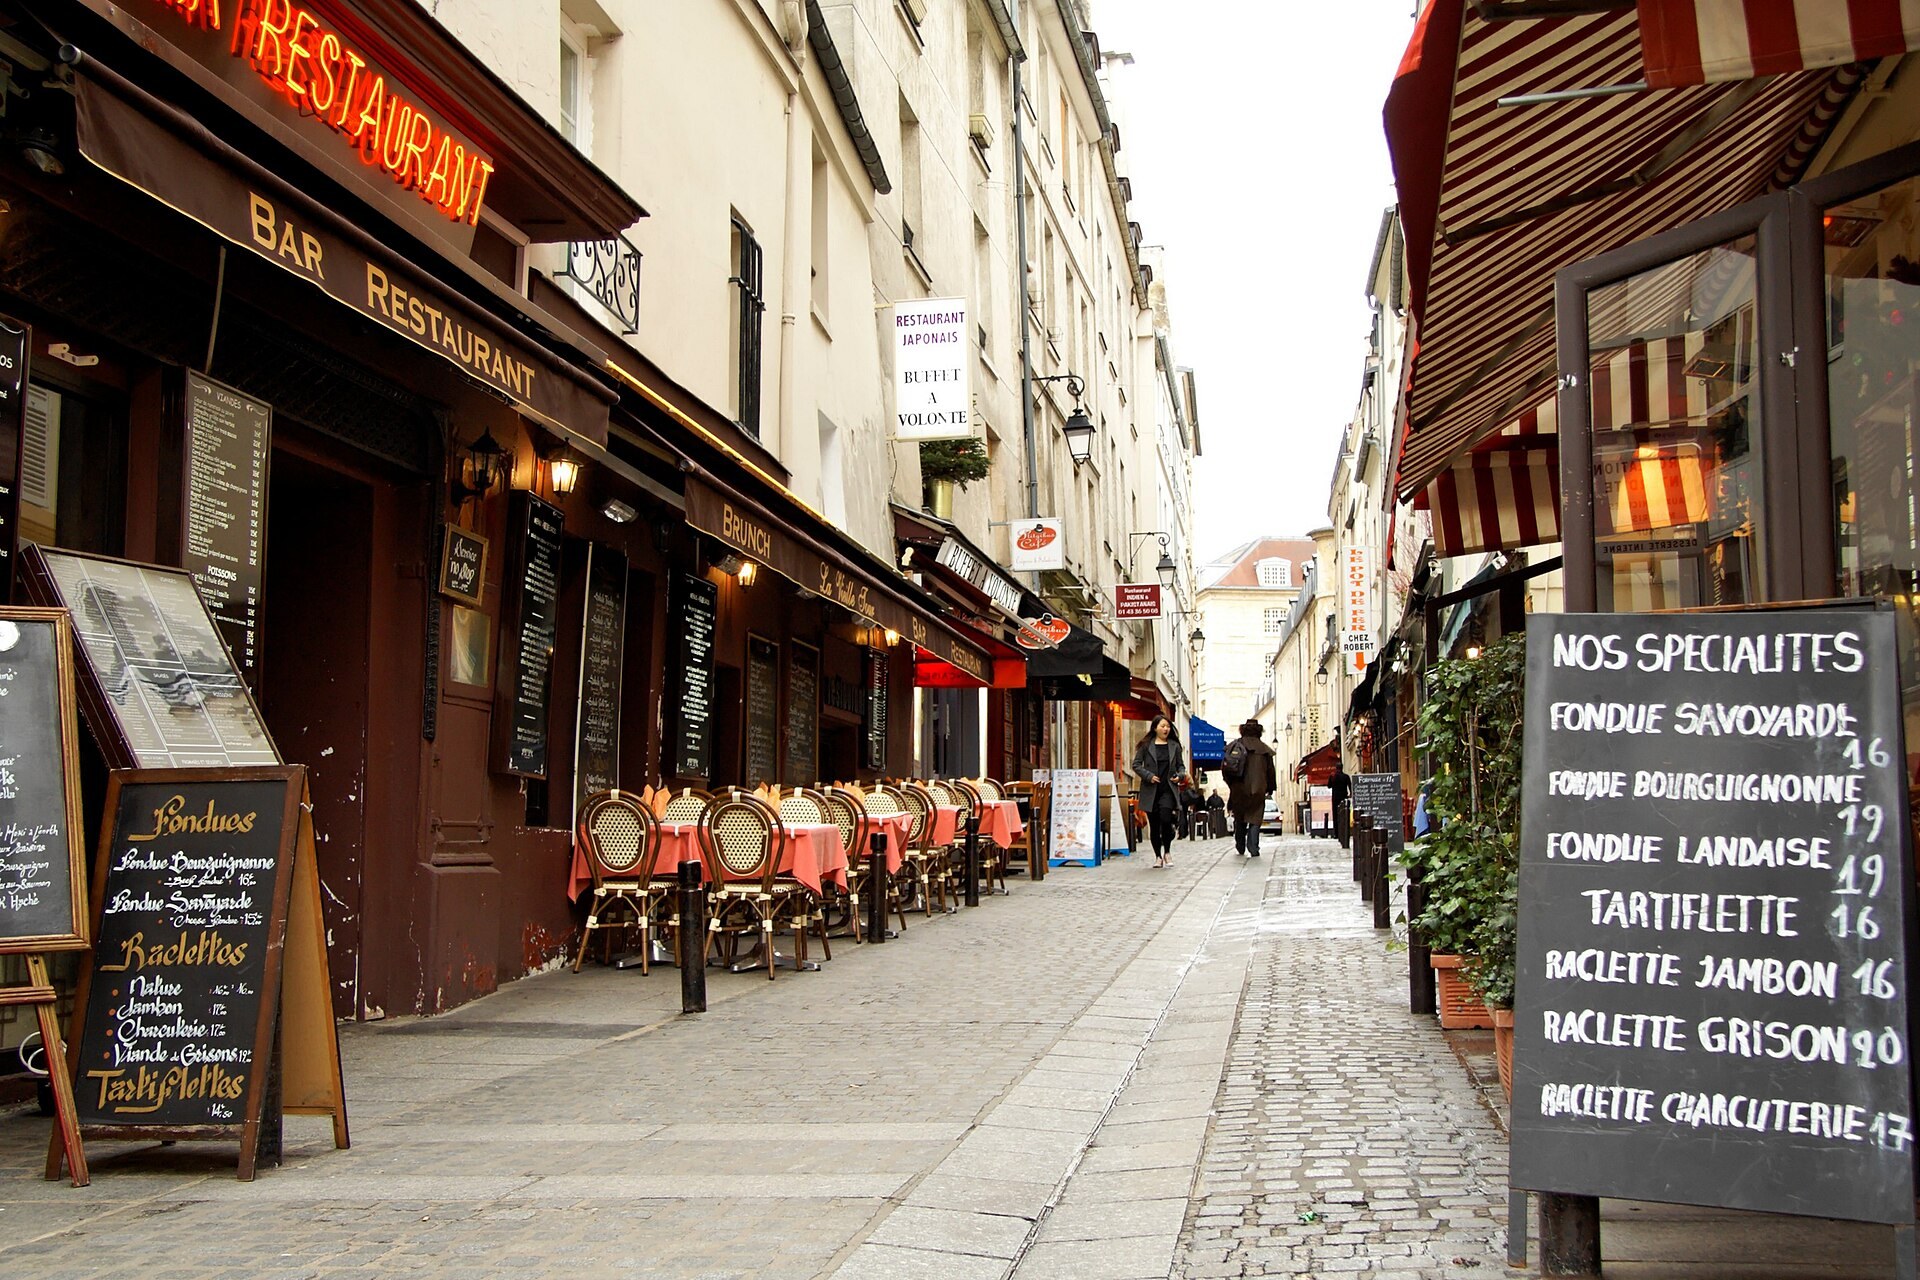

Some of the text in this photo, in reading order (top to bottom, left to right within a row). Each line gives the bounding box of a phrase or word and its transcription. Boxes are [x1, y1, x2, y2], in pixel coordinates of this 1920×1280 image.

[257, 0, 495, 226] RESTAURANT
[250, 192, 535, 400] BAR RESTAURANT
[896, 311, 965, 327] RESTAURANT
[903, 331, 958, 346] JAPONAIS
[904, 368, 962, 384] BUFFET
[216, 392, 241, 408] VIANDES
[927, 391, 938, 405] A
[898, 411, 967, 427] VOLONTE
[723, 503, 771, 559] BRUNCH
[207, 564, 236, 581] POISSONS
[948, 545, 1019, 612] BUFFET A VOLONTE
[1350, 566, 1364, 586] POT
[1351, 591, 1365, 604] DE
[912, 616, 927, 646] BAR
[1343, 642, 1374, 651] ROBERT
[1348, 634, 1369, 642] CHEZ
[1553, 632, 1865, 674] NOS SPECIALITES
[1550, 702, 1858, 737] FONDUE SAVOYARDE
[1842, 738, 1891, 769] 16
[1549, 770, 1866, 804] FONDUE BOURGUIGNONNE
[128, 794, 257, 842] Fondues
[1837, 804, 1885, 843] 19
[113, 847, 276, 880] Fondue Bourguignonne
[1547, 832, 1832, 870] FONDUE LANDAISE
[1831, 853, 1885, 899] 19
[105, 888, 253, 917] Fondue Savoyarde
[1580, 888, 1881, 941] TARTIFLETTE 16
[100, 931, 249, 972] Raclettes
[129, 974, 183, 997] Nature
[1545, 949, 1897, 1000] RACLETTE JAMBON 16
[116, 995, 184, 1021] Jambon
[117, 1016, 208, 1044] Charcuterie
[1544, 1009, 1687, 1052] RACLETTE
[1697, 1016, 1848, 1066] GRISON
[114, 1040, 169, 1068] Viande
[180, 1042, 238, 1067] Grisons
[86, 1062, 246, 1115] Tartiflettes
[1541, 1083, 1914, 1152] RACLETTE CHARCUTERIE 17
